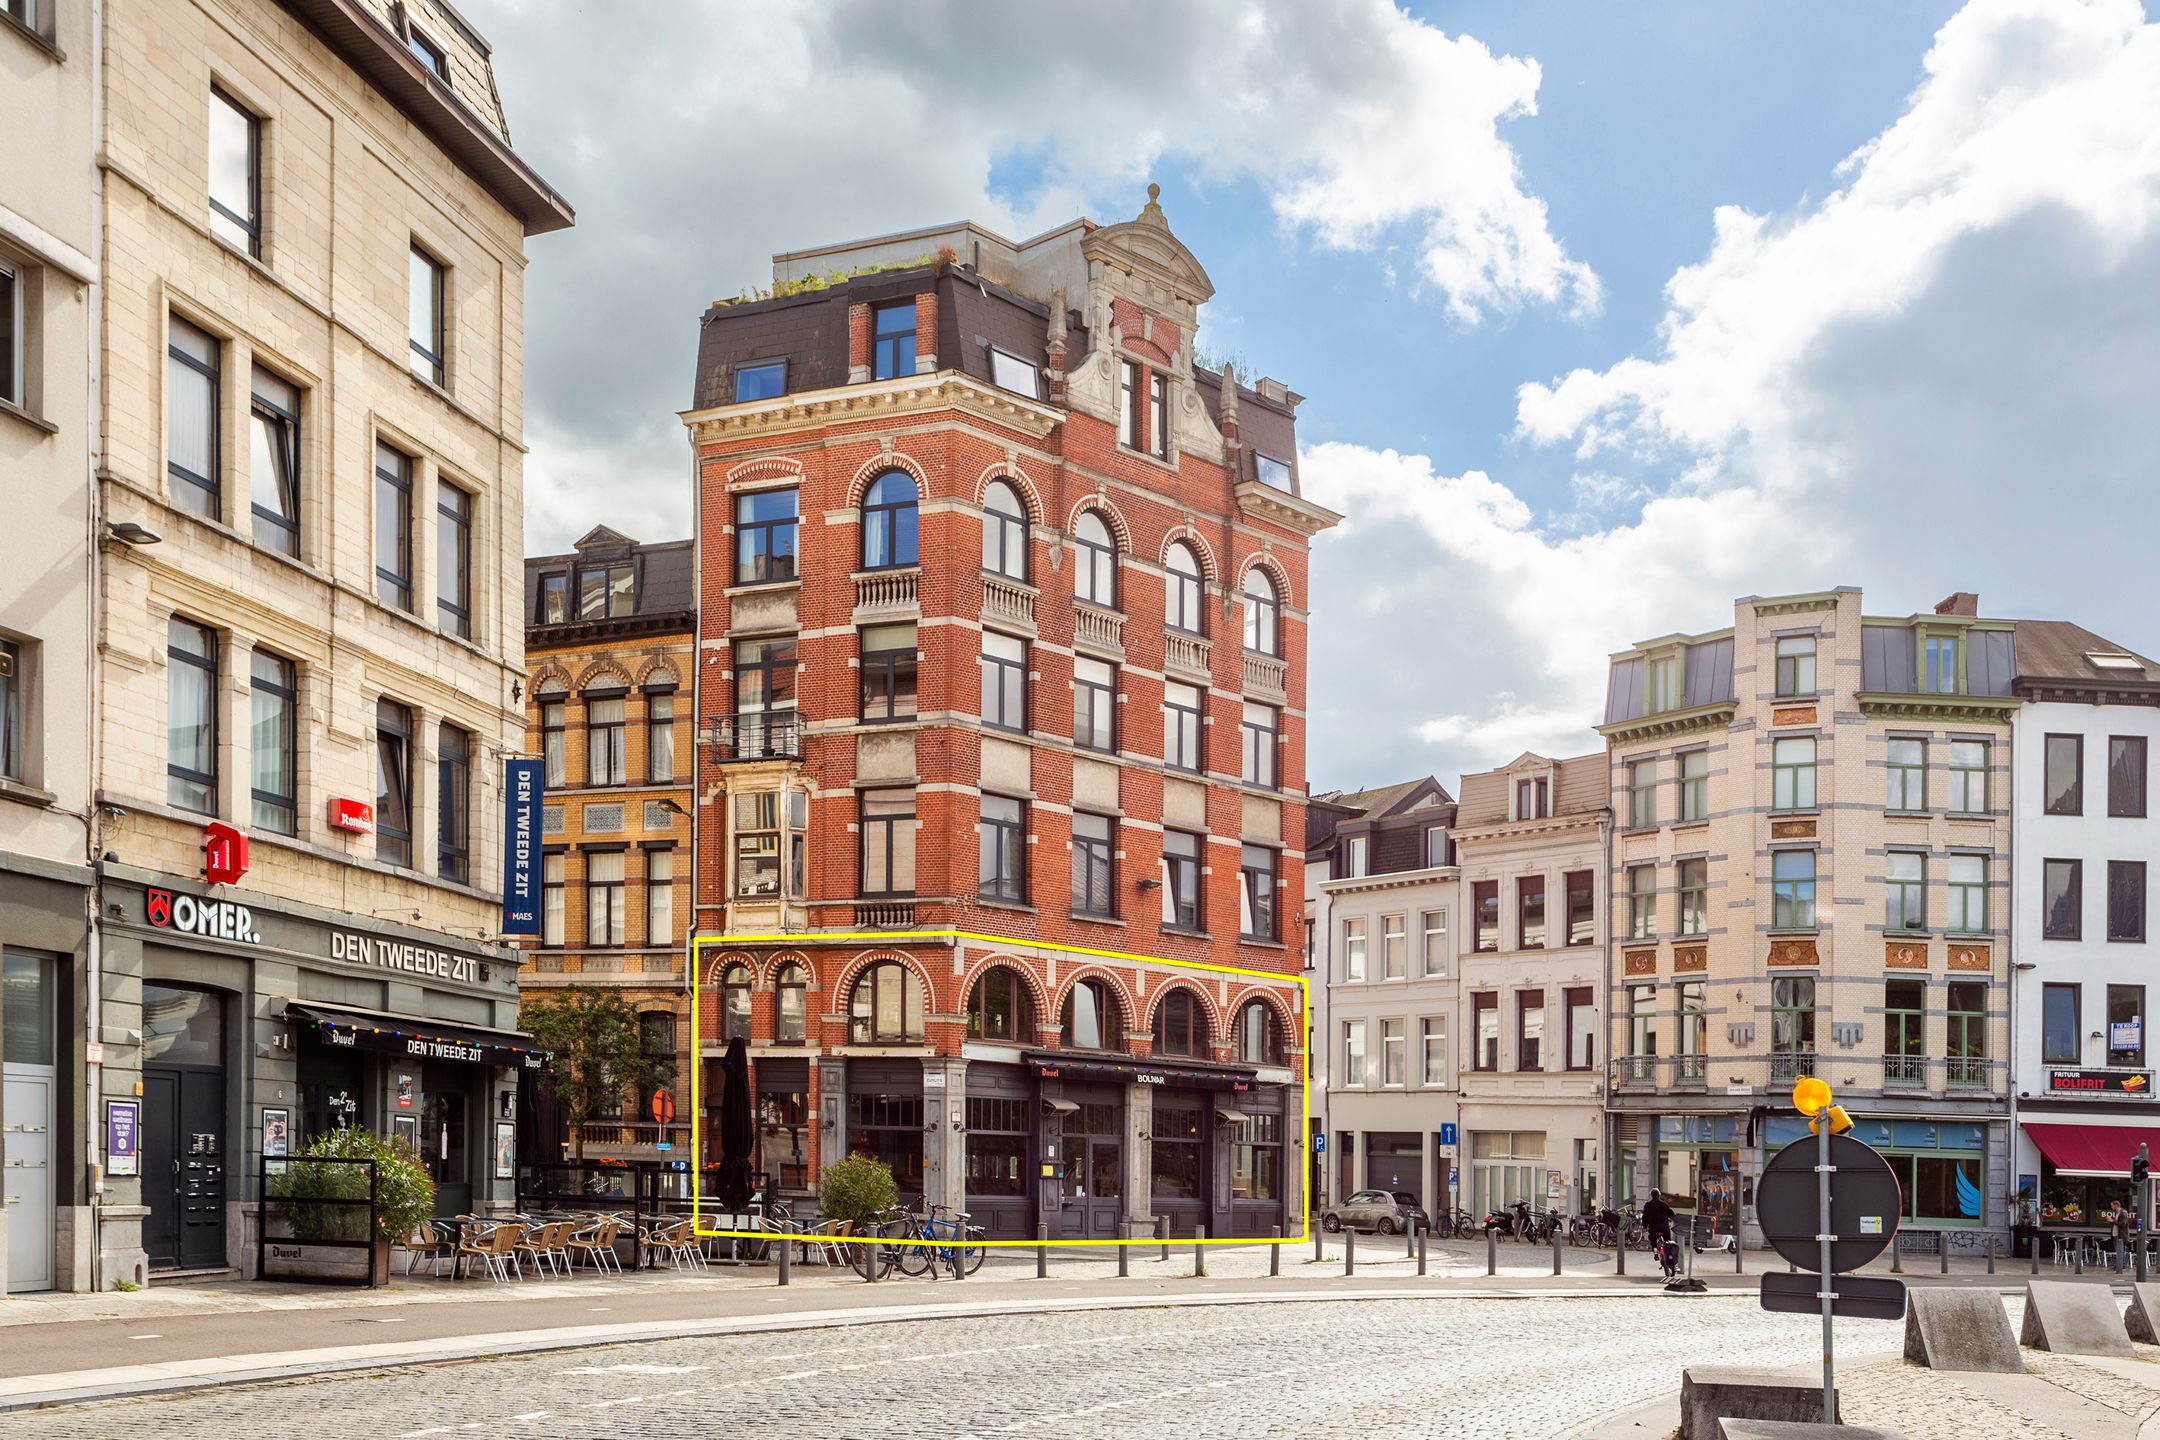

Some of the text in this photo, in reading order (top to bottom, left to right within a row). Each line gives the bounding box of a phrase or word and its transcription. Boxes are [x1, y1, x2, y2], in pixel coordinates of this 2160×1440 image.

[515, 770, 531, 898] DEN TWEEDE ZIT
[513, 912, 533, 921] MAES
[332, 932, 476, 982] DEN TWEEDE ZIT
[332, 1029, 356, 1046] Duvel
[407, 1040, 483, 1062] DEN TWEEDE ZIT
[525, 1055, 542, 1068] Duvel
[1042, 1068, 1059, 1077] Duvel
[1233, 1082, 1249, 1091] Duvel
[2054, 1078, 2106, 1089] BOLIFRIT
[329, 1096, 340, 1106] Den
[345, 1100, 356, 1112] Zit
[1316, 1136, 1324, 1150] P
[271, 1245, 302, 1258] Duvel
